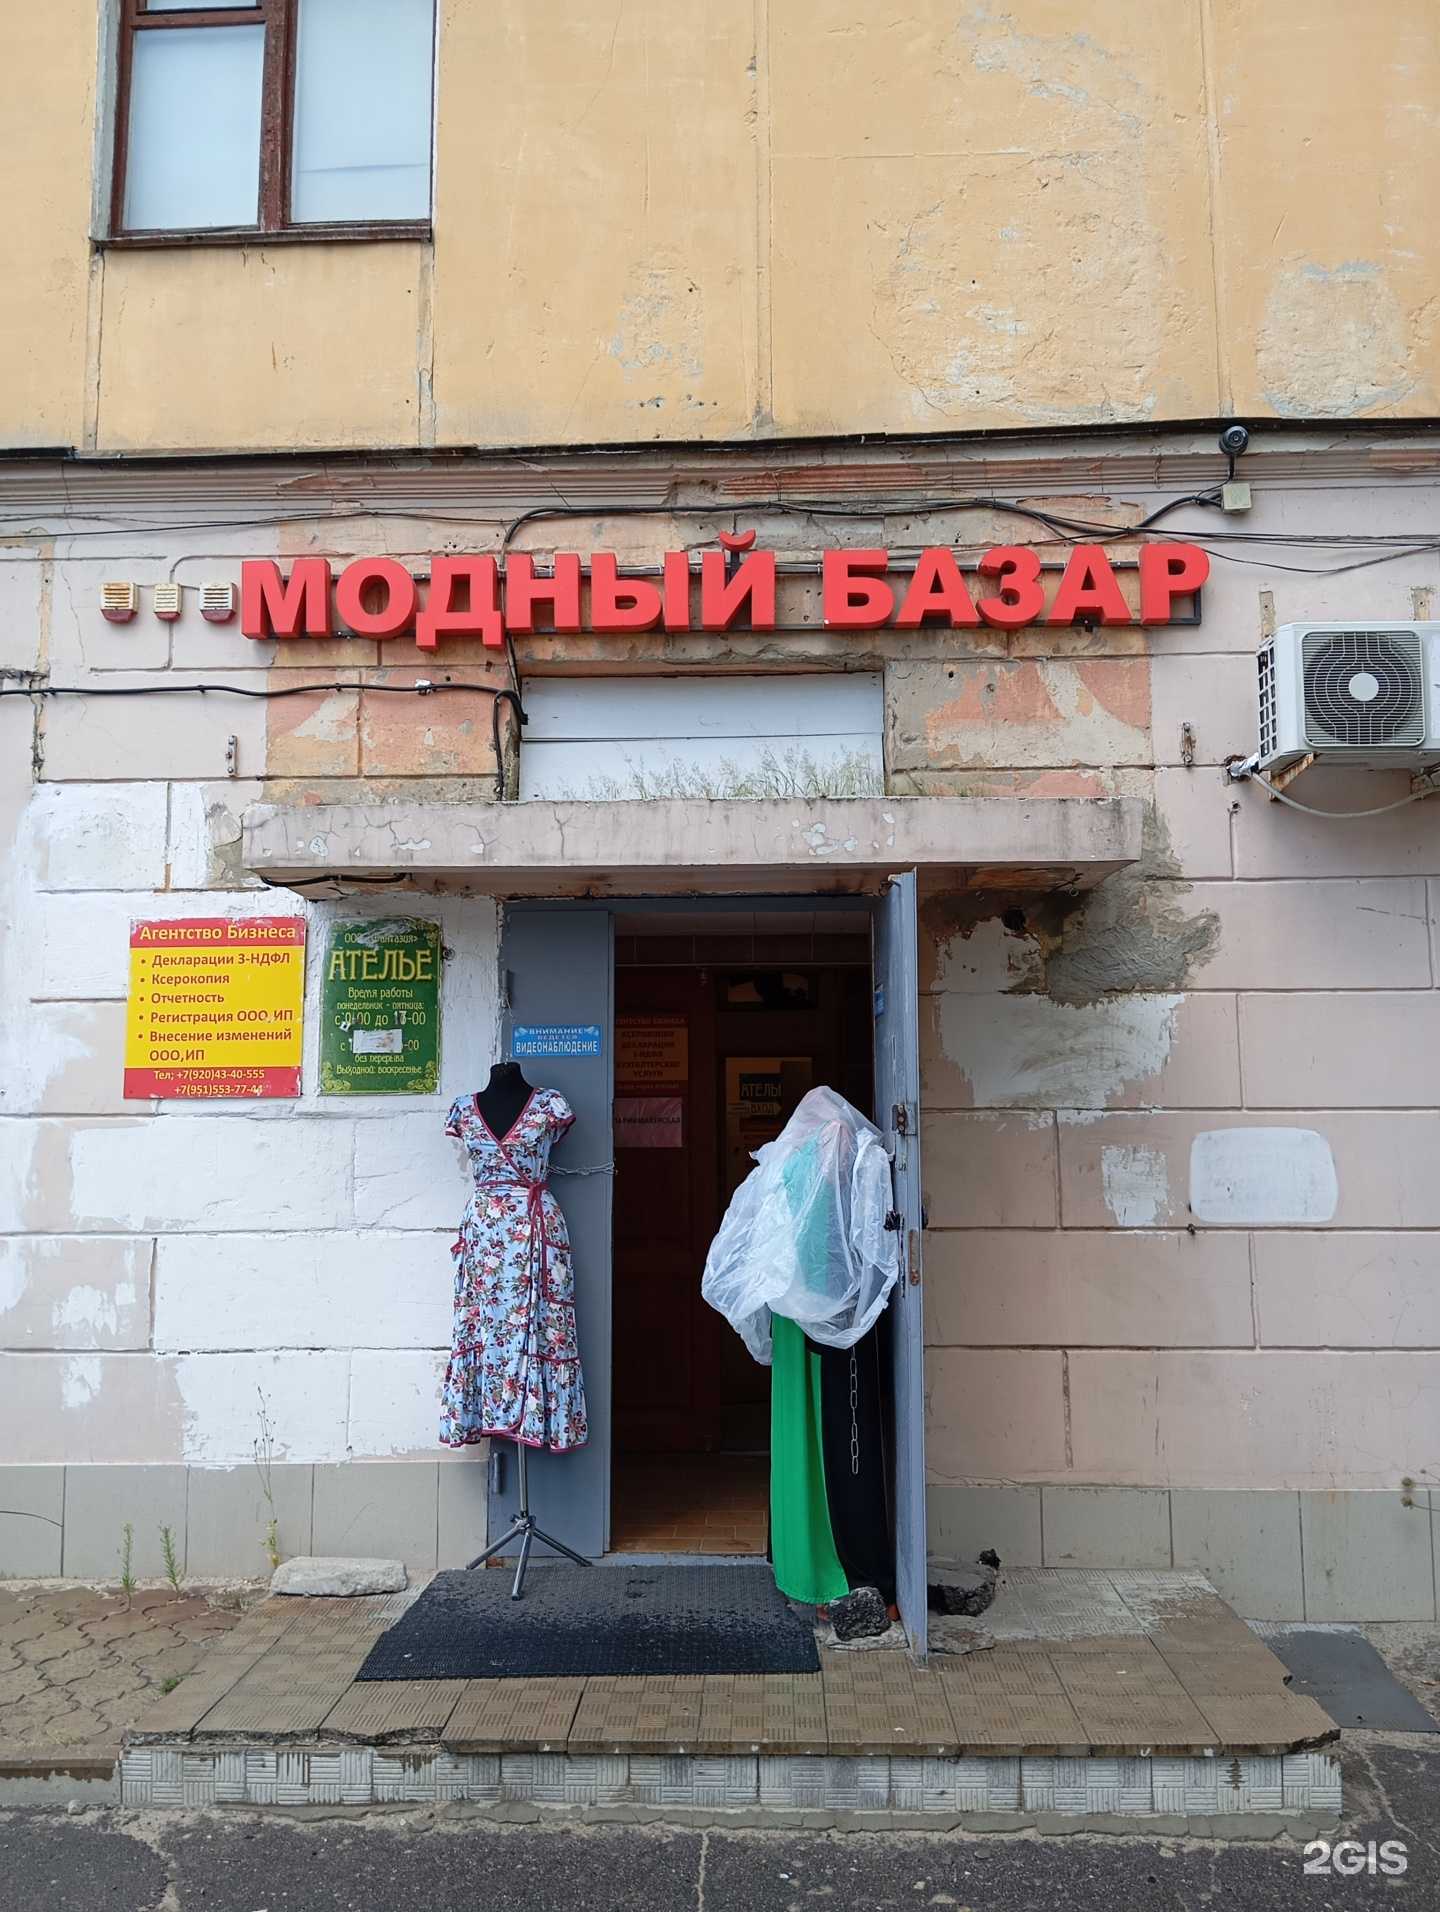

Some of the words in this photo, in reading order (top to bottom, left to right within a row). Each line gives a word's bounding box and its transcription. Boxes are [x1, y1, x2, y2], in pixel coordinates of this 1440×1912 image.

[241, 529, 775, 651] МОДНЫЙ
[822, 544, 1210, 631] БАЗАР
[140, 926, 222, 941] Агентство
[227, 925, 296, 940] Бизнеса
[152, 954, 234, 968] Декларации
[238, 952, 290, 966] 3-НДФЛ
[328, 949, 432, 980] АТЕЛЬЕ
[151, 973, 230, 987] Ксерокопия
[151, 992, 224, 1004] Отчетность
[348, 987, 377, 999] Время
[380, 987, 413, 1000] работы
[150, 1012, 233, 1025] Регистрация
[375, 1015, 389, 1027] до
[150, 1030, 212, 1042] Внесение
[216, 1028, 292, 1041] изменений
[515, 1040, 598, 1055] ВИДЕОНАБЛЮДЕНИЕ
[150, 1049, 204, 1063] ООО,ИП
[177, 1069, 265, 1081] +7(920)43-40-555
